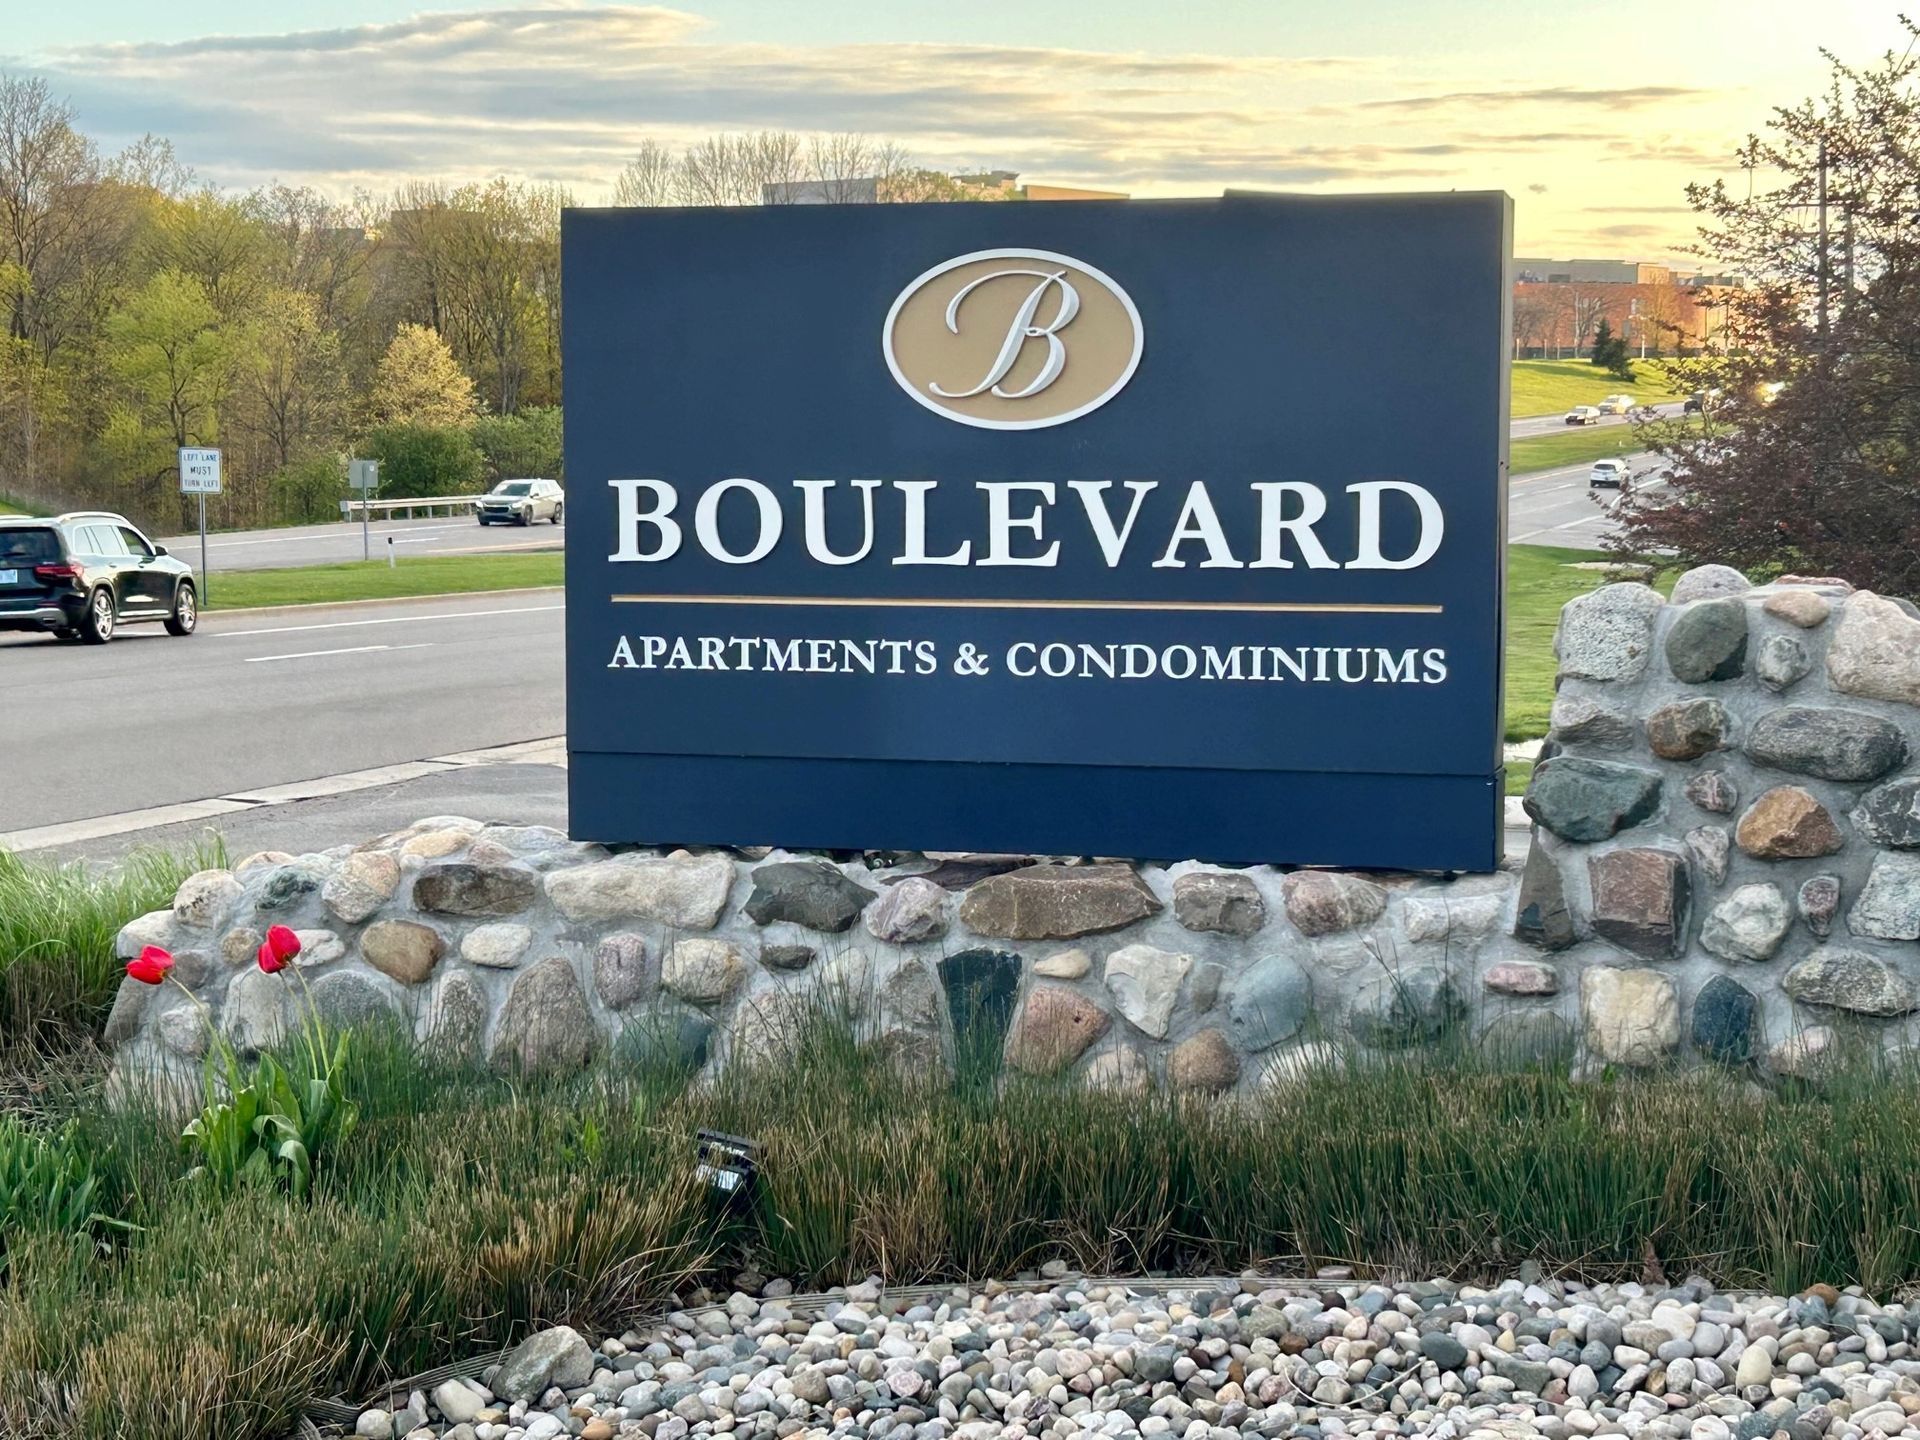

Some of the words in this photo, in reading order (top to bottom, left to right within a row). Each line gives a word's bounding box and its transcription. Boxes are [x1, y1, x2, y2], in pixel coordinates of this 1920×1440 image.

[929, 269, 1080, 399] B
[183, 453, 199, 461] LEFT
[201, 454, 217, 462] LANE
[190, 466, 211, 475] MUST
[184, 479, 200, 487] TURN
[203, 480, 219, 488] LEFT
[607, 478, 1446, 571] BOULEVARD
[607, 635, 938, 676] APARTMENTS
[953, 642, 990, 677] &
[1006, 642, 1448, 685] CONDOMINIUMS
